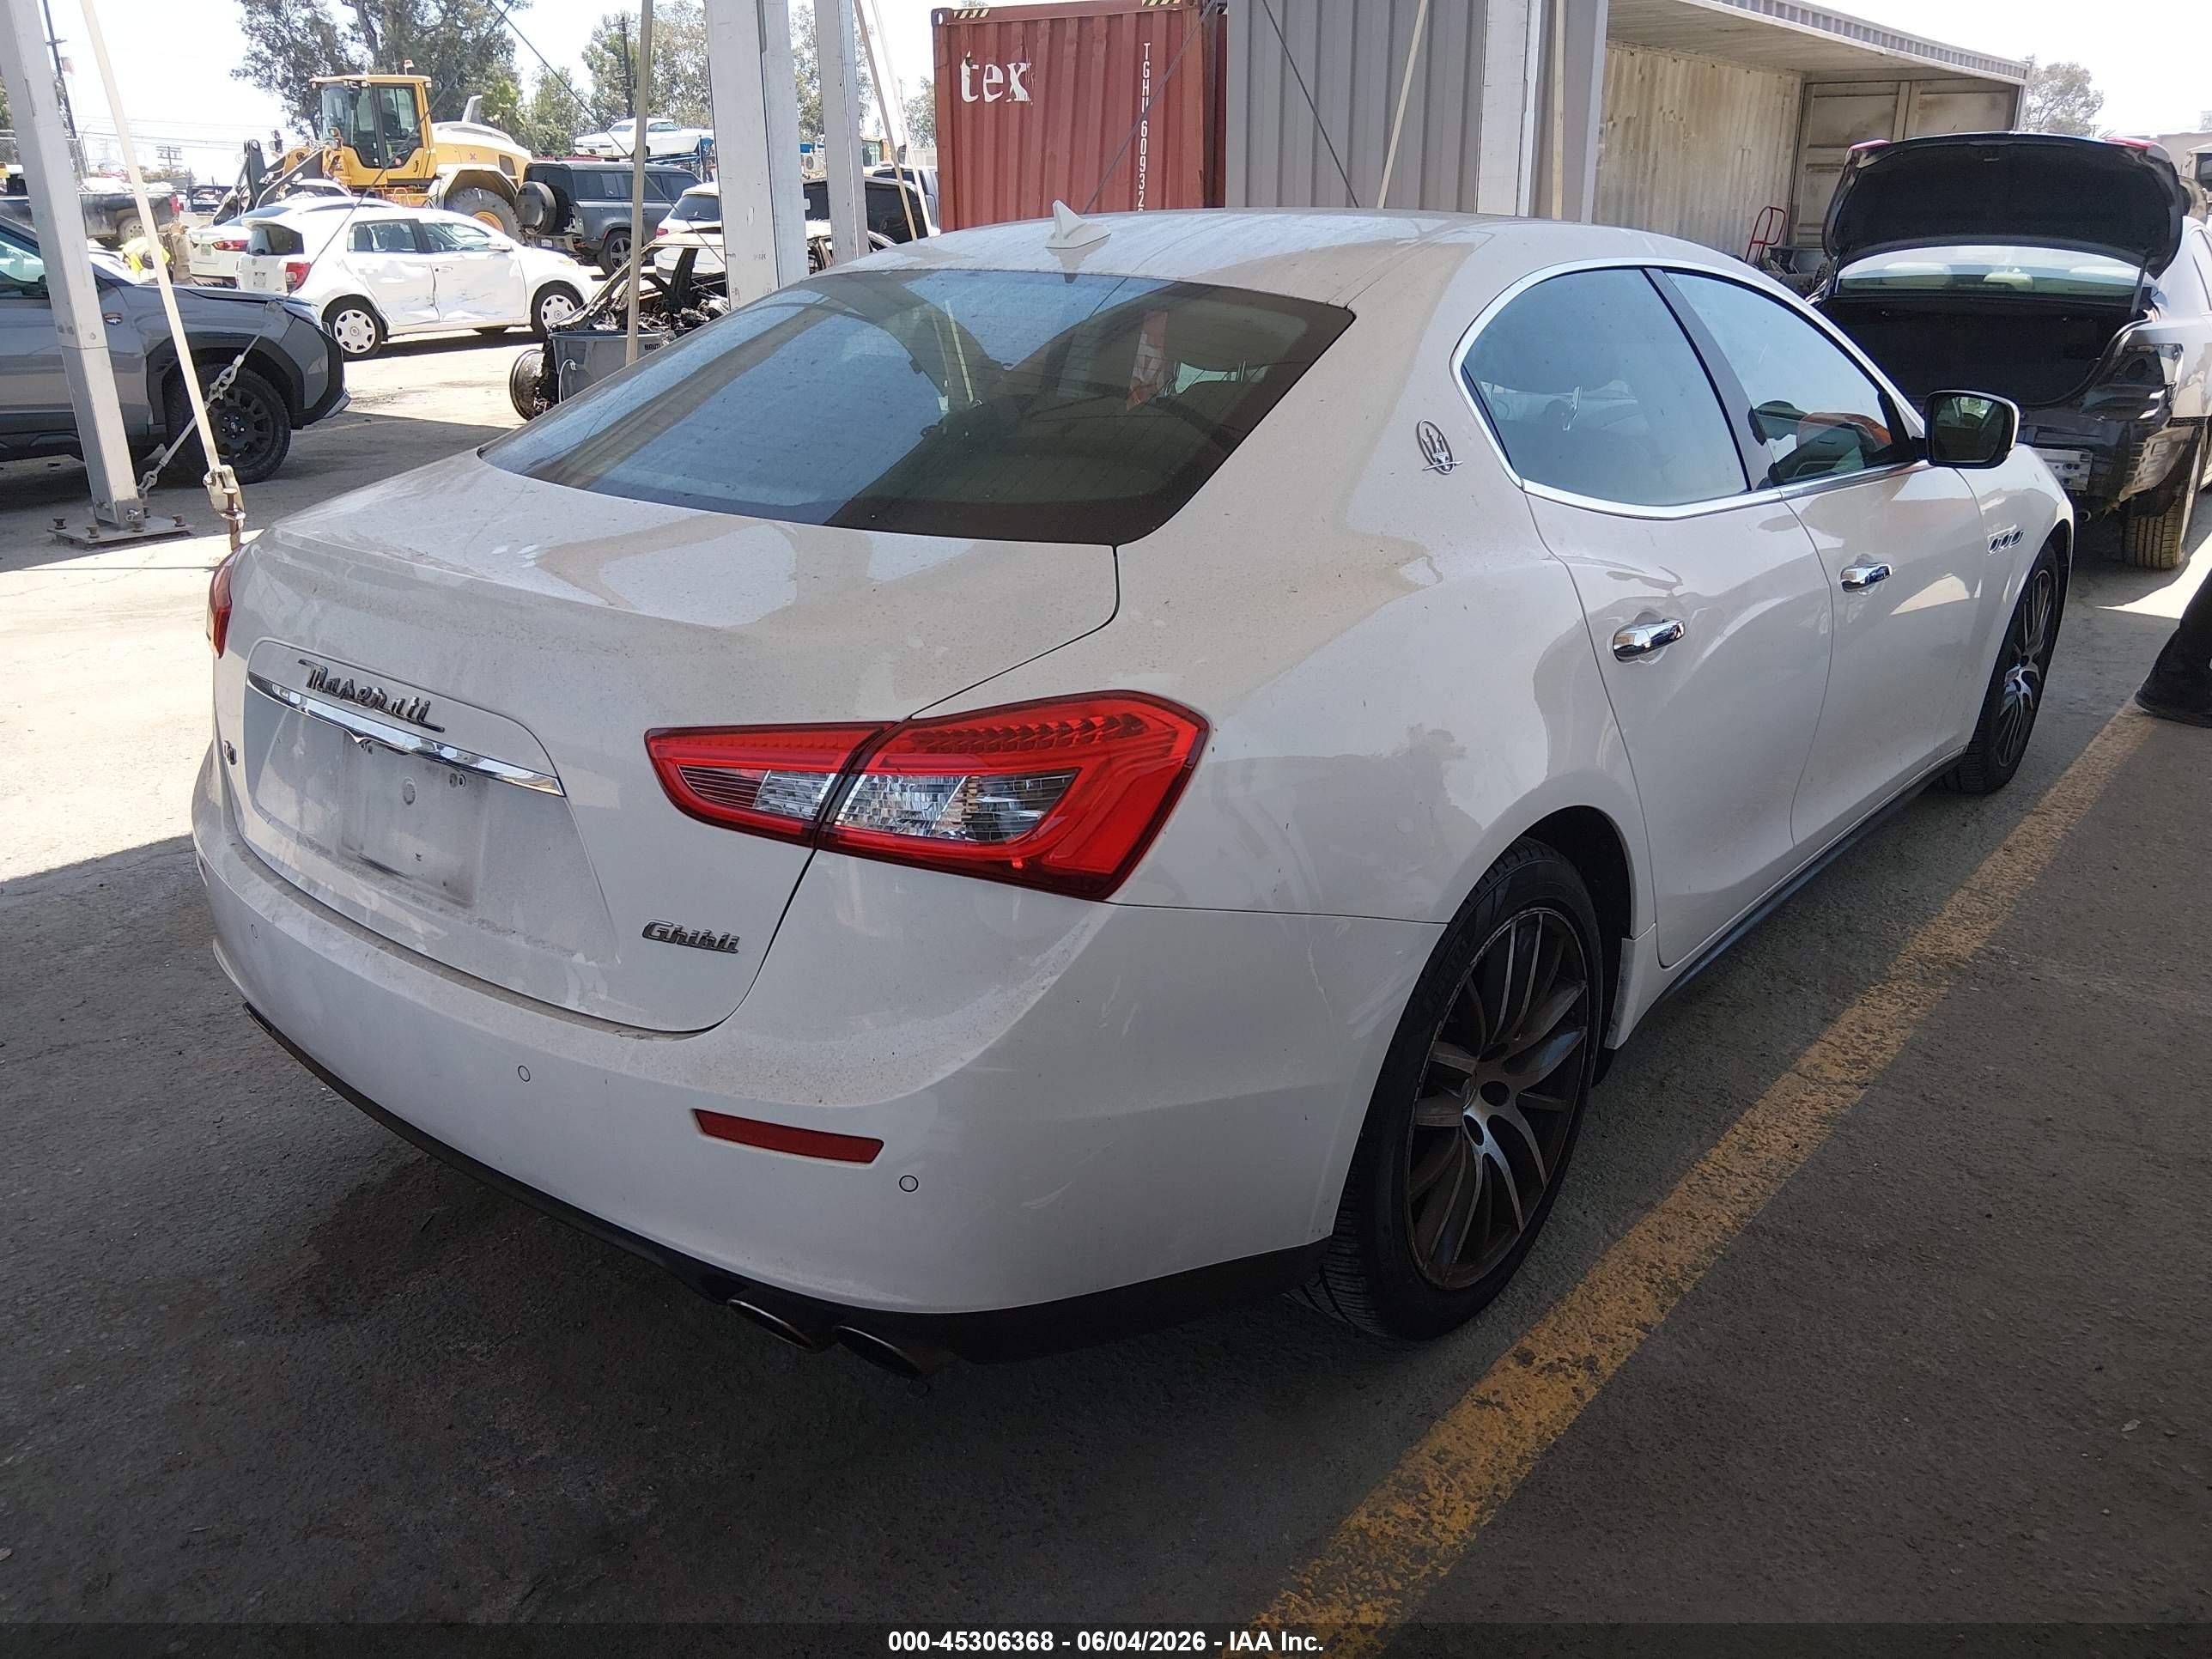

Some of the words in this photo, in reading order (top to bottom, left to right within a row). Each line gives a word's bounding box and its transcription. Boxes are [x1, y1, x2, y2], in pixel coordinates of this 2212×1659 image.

[960, 51, 1032, 103] tex
[1138, 120, 1148, 212] 60932
[298, 659, 446, 732] Maserati
[642, 920, 739, 954] Ghibli
